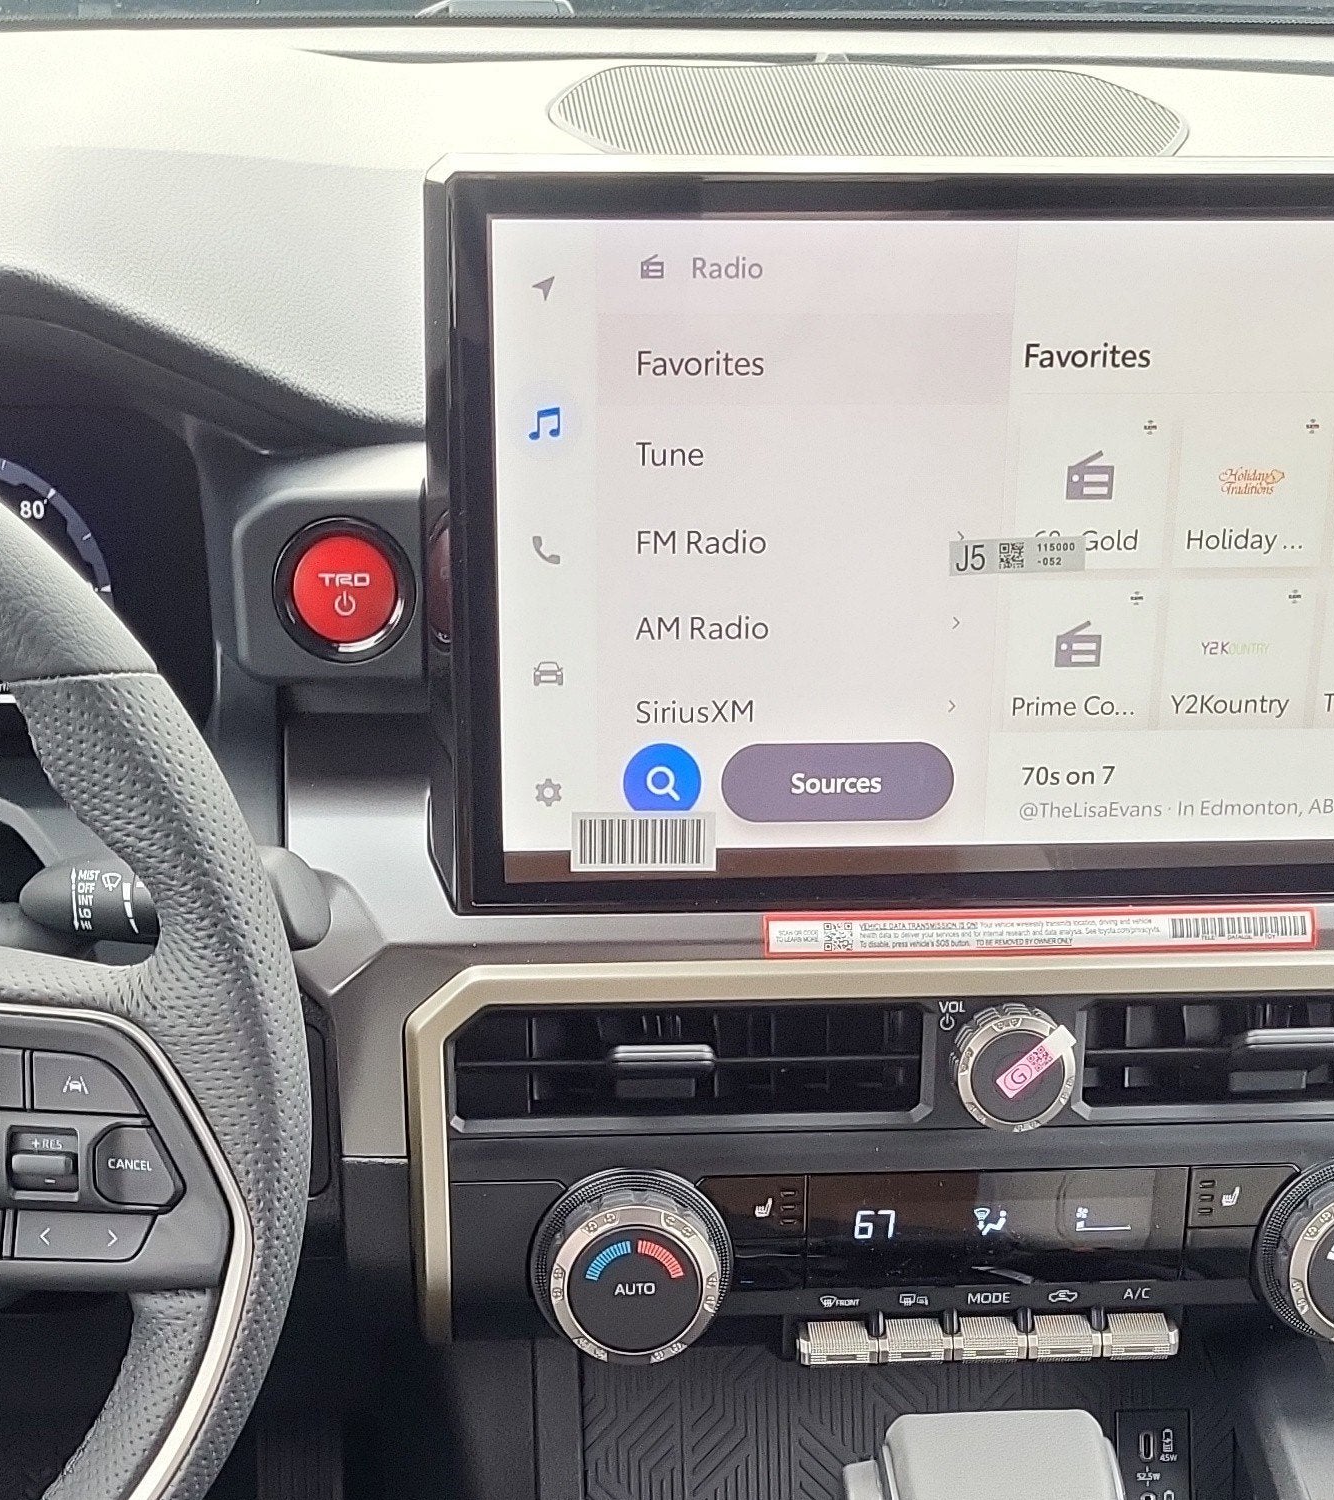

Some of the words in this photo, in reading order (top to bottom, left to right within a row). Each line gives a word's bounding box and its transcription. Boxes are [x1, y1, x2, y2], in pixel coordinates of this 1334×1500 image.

[691, 256, 764, 280] Radio
[636, 351, 765, 377] Favorites
[1024, 343, 1152, 370] Favorites
[636, 442, 705, 467] Tune
[20, 500, 45, 519] 80
[636, 531, 677, 555] FM
[685, 530, 767, 555] Radio
[1037, 542, 1076, 552] 115000
[1083, 529, 1138, 551] Gold
[1186, 528, 1278, 554] Holiday
[955, 544, 986, 572] J5
[1037, 557, 1063, 566] -052
[318, 572, 371, 588] TRD
[635, 616, 682, 641] AM
[689, 615, 769, 641] Radio
[636, 700, 755, 725] SiriusXM
[1011, 696, 1077, 717] Prime
[1170, 693, 1289, 719] Y2Kountry
[790, 772, 882, 795] Sources
[1021, 766, 1060, 786] 70s
[1066, 771, 1095, 786] on
[1102, 766, 1116, 785] 7
[1019, 801, 1162, 821] @TheLisaEvans
[1177, 801, 1194, 817] In
[1200, 799, 1303, 818] Edmonton,
[1308, 799, 1334, 815] AB
[78, 870, 100, 881] MIST
[77, 882, 95, 893] OFF
[78, 895, 93, 906] INT
[78, 908, 91, 919] LO
[939, 1001, 966, 1013] VOL
[1011, 1068, 1028, 1085] G
[107, 1157, 152, 1172] CANCEL
[854, 1210, 896, 1239] 67
[614, 1281, 656, 1296] AUTO
[968, 1291, 1011, 1305] MODE
[1123, 1286, 1151, 1300] A/C
[835, 1298, 860, 1307] FRONT
[1159, 1454, 1178, 1462] 45W
